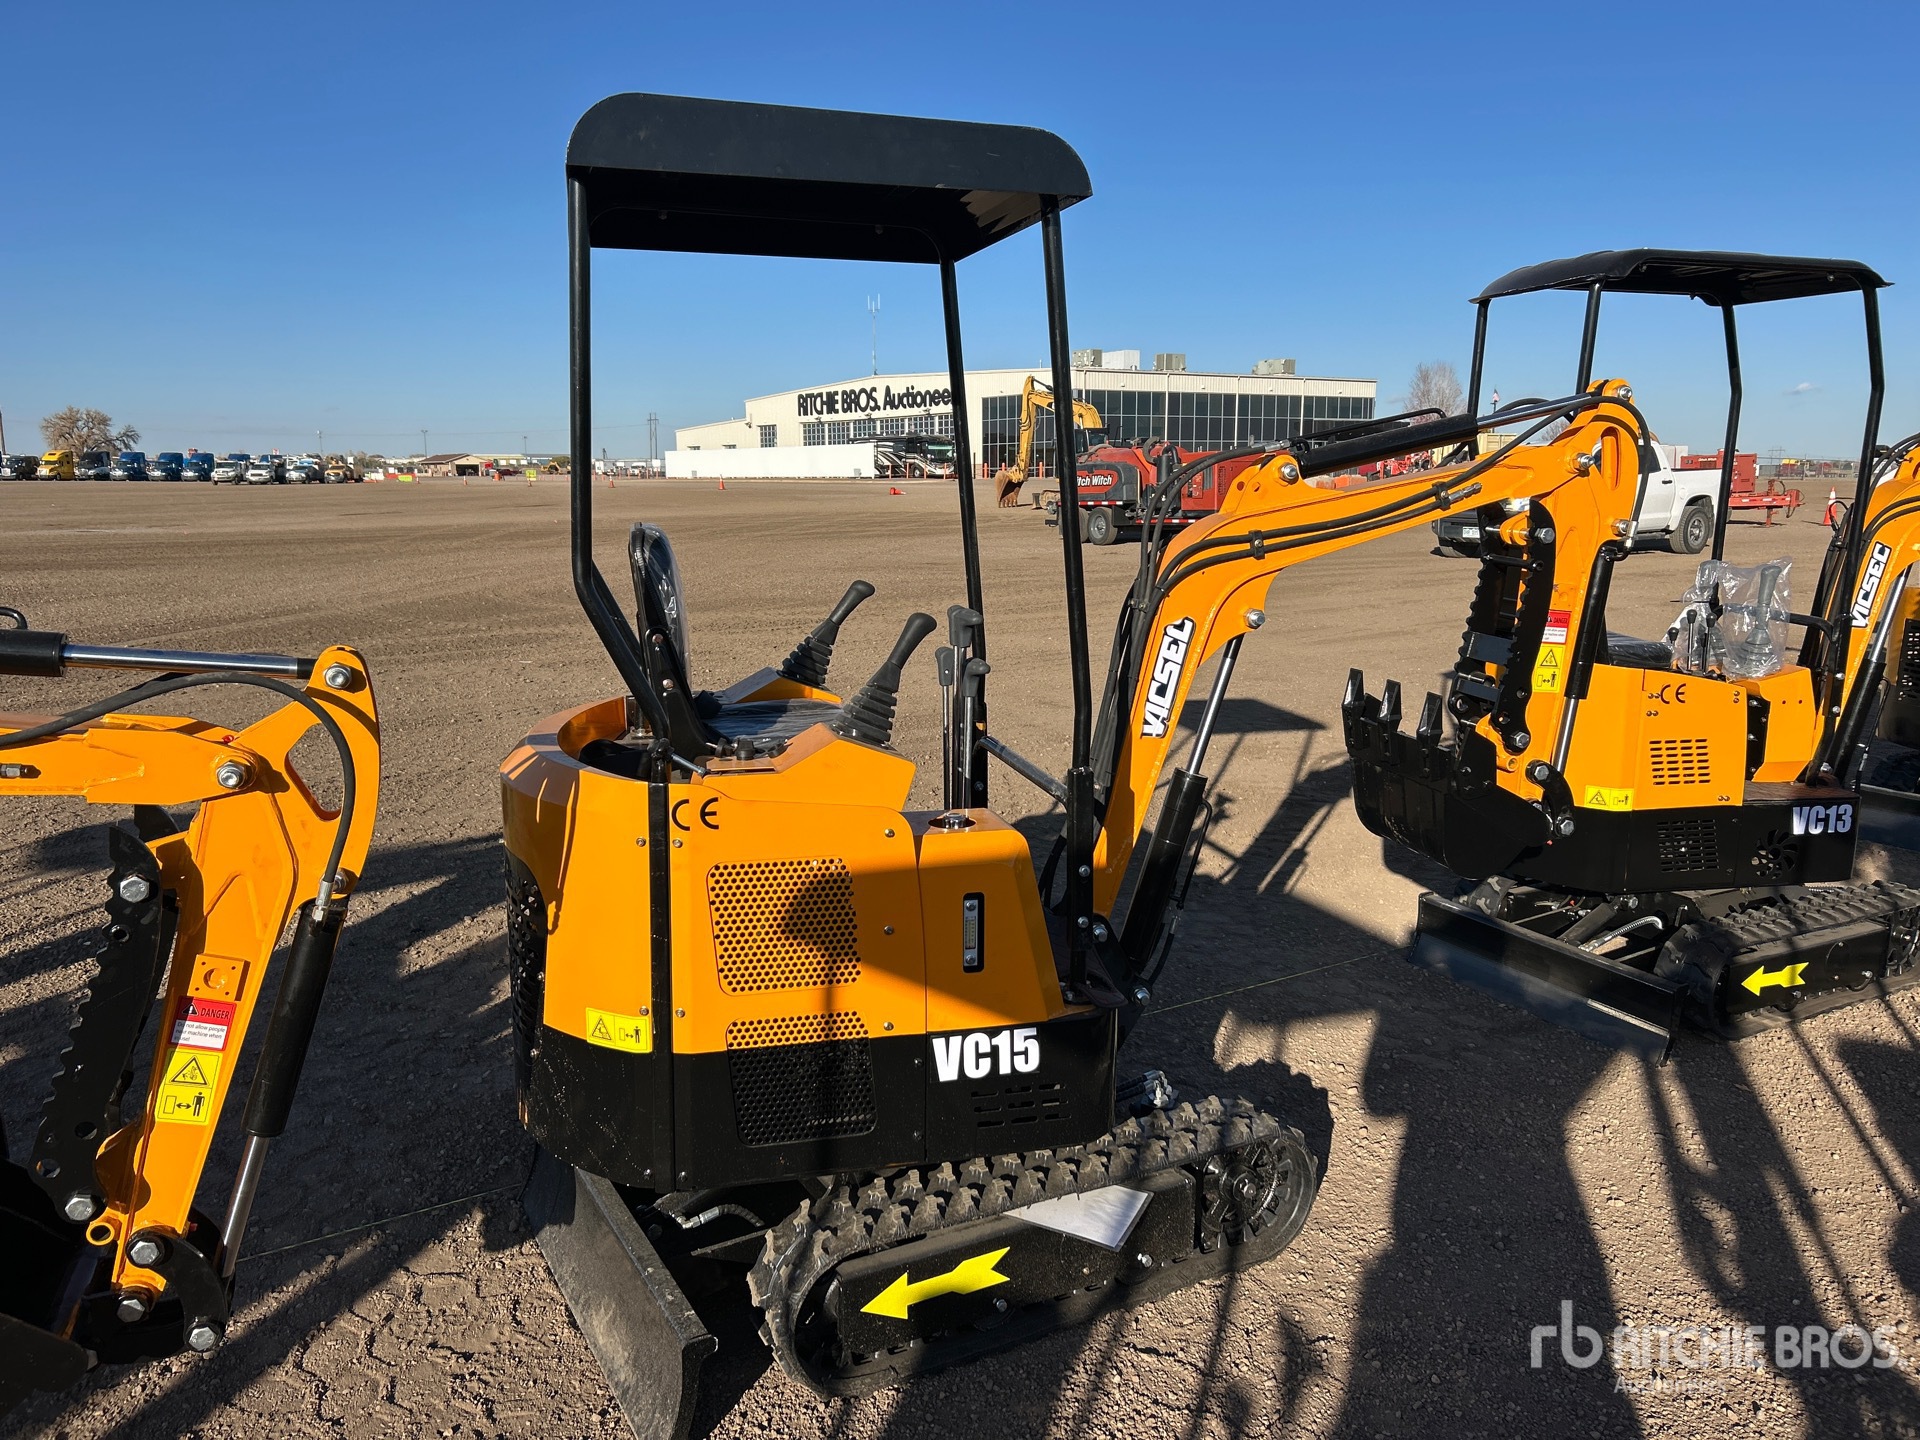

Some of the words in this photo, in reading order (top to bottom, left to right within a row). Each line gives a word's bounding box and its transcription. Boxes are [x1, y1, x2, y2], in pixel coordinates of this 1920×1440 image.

[797, 390, 839, 416] RITCHIE
[841, 386, 880, 413] BROS.
[883, 385, 953, 410] Auctionee
[1077, 475, 1091, 487] itch
[1091, 474, 1113, 486] Witch
[1851, 542, 1892, 628] VICSEC
[1141, 617, 1195, 738] VICSEC
[1660, 683, 1686, 704] CE
[671, 796, 719, 831] CE
[1792, 804, 1853, 835] VC13
[200, 1007, 230, 1020] DANGER
[932, 1027, 1040, 1082] VC15
